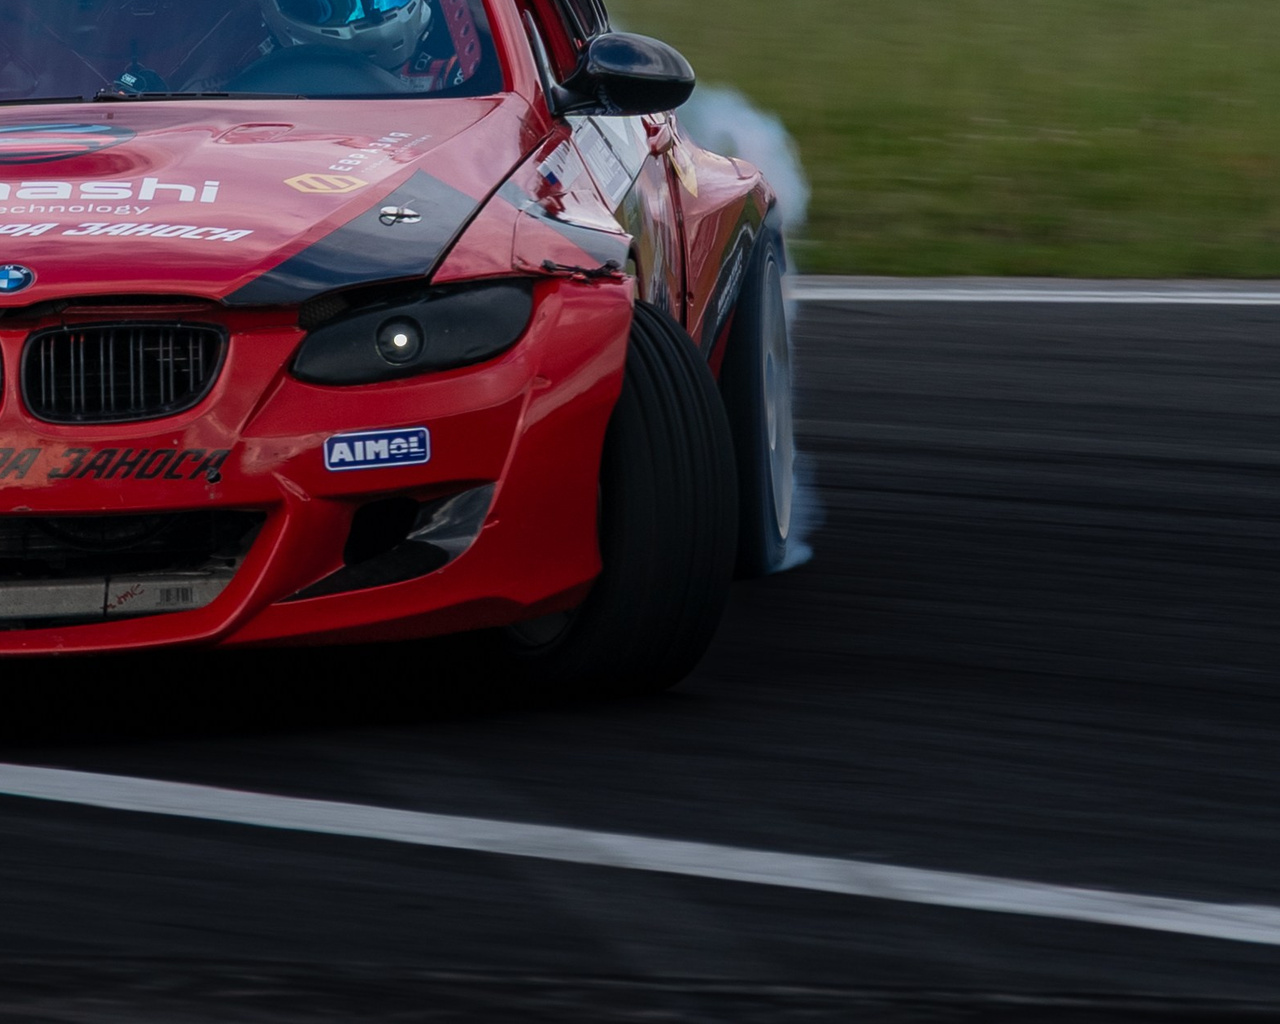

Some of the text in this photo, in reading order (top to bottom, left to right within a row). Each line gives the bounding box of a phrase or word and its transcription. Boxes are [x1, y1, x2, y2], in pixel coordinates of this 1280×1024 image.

[61, 221, 255, 242] ЗАНОСА
[47, 447, 231, 480] ЗАНОСА
[328, 435, 426, 464] AIMOL
